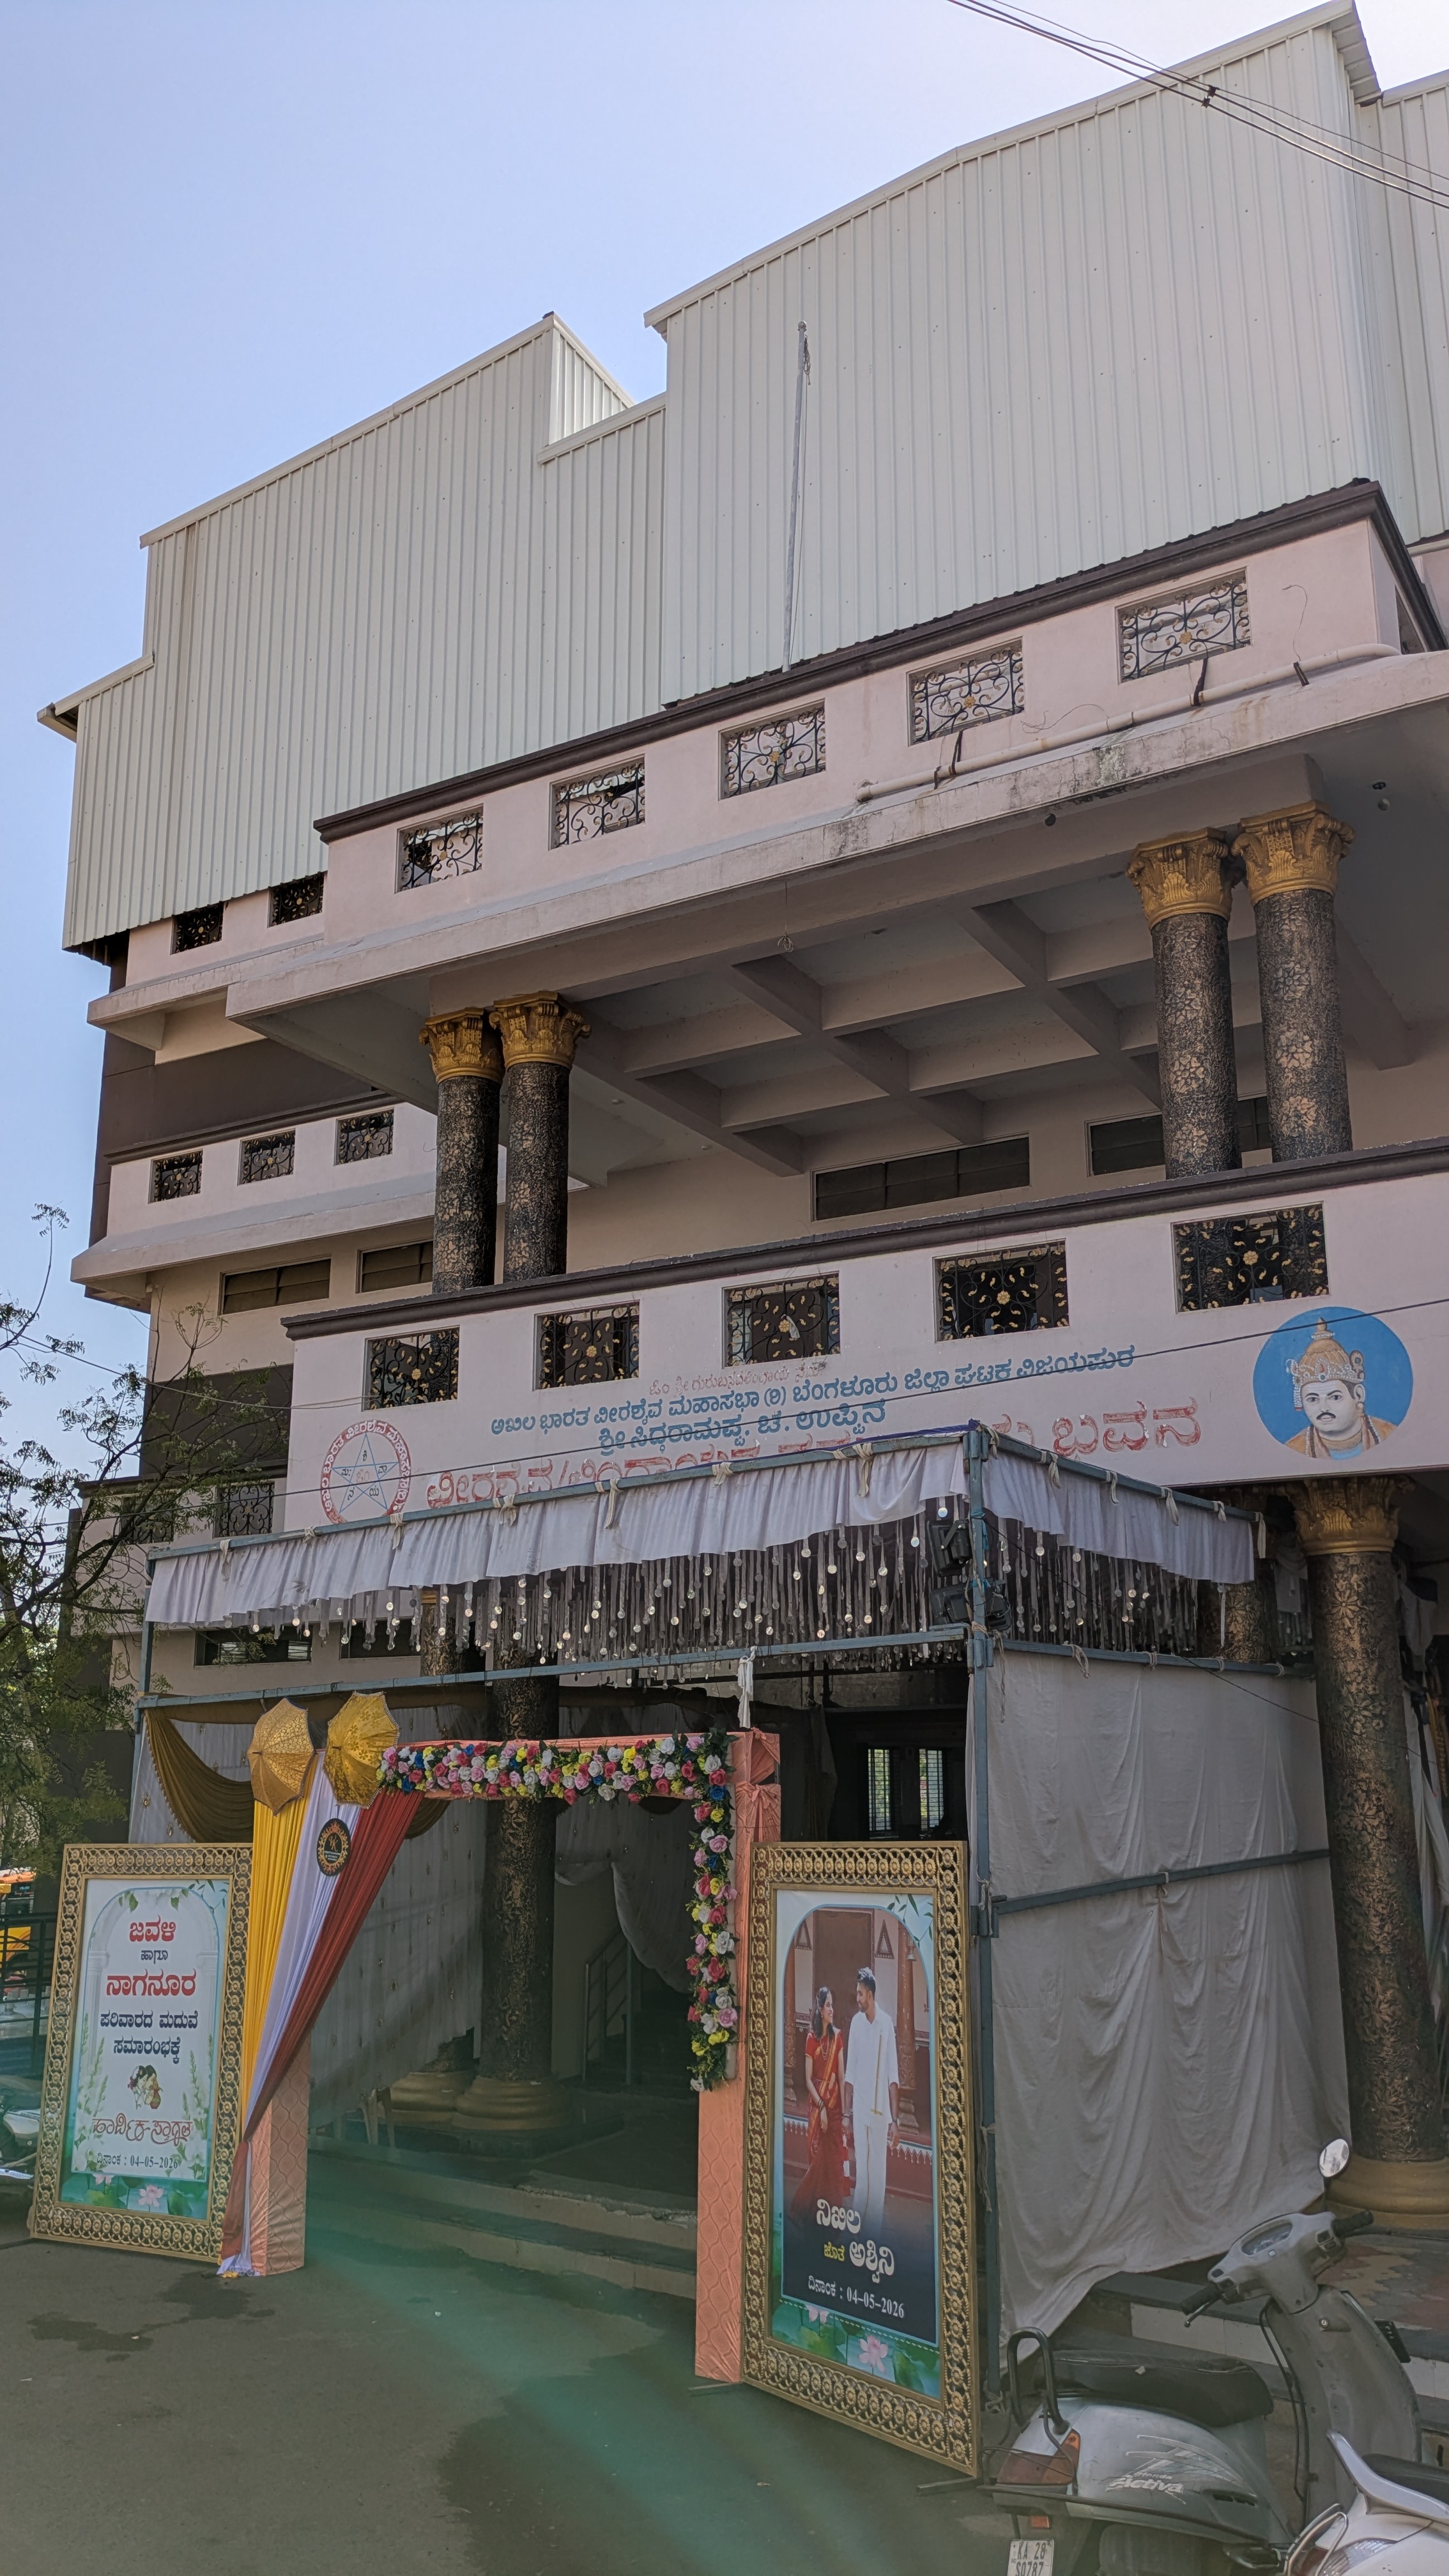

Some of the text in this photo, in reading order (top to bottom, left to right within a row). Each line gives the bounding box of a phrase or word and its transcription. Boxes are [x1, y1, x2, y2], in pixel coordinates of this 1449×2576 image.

[491, 1344, 1135, 1435] ಅಖಿಲ ಭಾರತ ವೀರಶೈವ ಮಹಾಸಭಾ (ರಿ) ಬೆಂಗಳೂರು ಜಿಲ್ಲಾ ಘಟಕ ವಿಜಯಪುರ
[598, 1427, 625, 1456] ಶ್ರೀ
[796, 1399, 886, 1434] ಉಪ್ಪಿನ
[1052, 1397, 1201, 1461] ಭವನ
[129, 1915, 176, 1942] ಜವಳಿ
[141, 1950, 169, 1965] ಹಾಗೂ
[106, 1968, 197, 1997] ನಾಗನೂರ
[100, 2009, 199, 2029] ಪರಿವಾರದ ಮದುವೆ
[113, 2035, 181, 2064] ಸಮಾರಂಭಕ್ಕೆ
[151, 2120, 194, 2147] ಸ್ವಾಗತ
[96, 2152, 121, 2166] ದಿನಾಂಕ
[130, 2155, 178, 2169] 04-05-2026
[816, 2198, 861, 2234] ನಿಖಿಲ
[824, 2240, 894, 2283] ಜೊತೆ ಅಶ್ವಿನಿ
[808, 2275, 836, 2297] ದಿನಾಂಕ
[847, 2287, 905, 2319] 04-05-2026
[1105, 2475, 1183, 2494] Activa
[1017, 2542, 1046, 2560] KA 28
